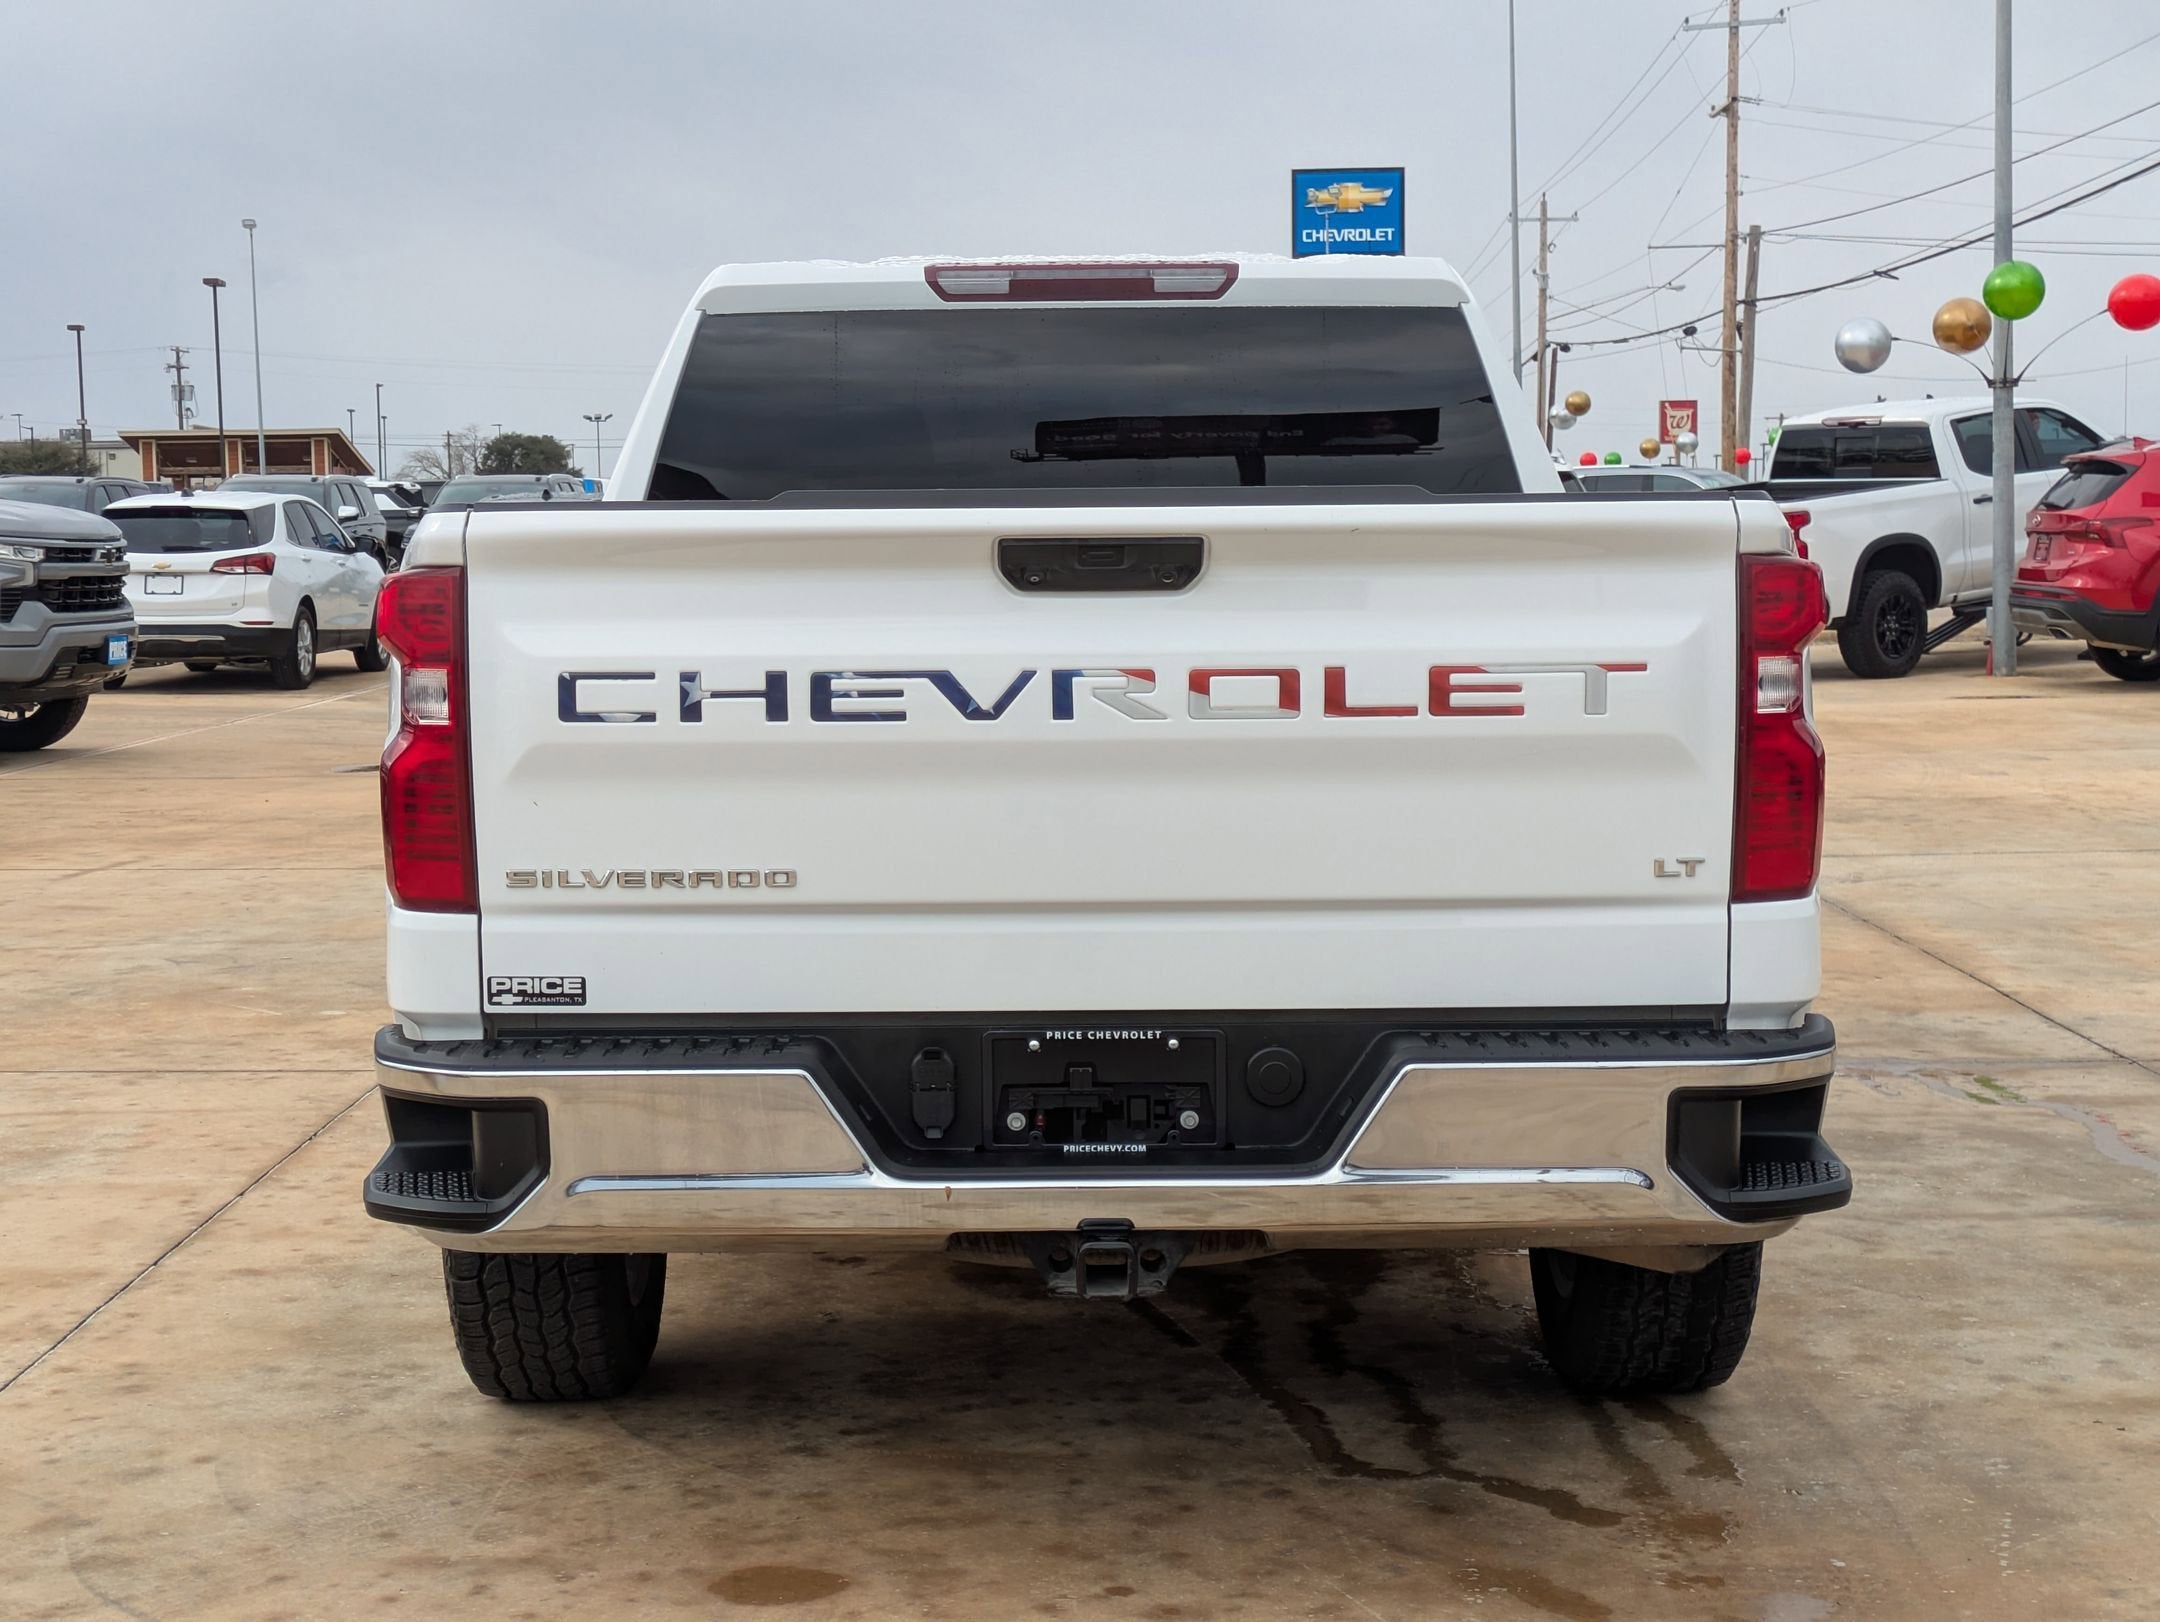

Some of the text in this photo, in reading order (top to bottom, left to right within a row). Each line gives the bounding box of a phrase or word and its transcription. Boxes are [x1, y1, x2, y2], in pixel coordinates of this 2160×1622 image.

[1302, 228, 1395, 242] CHEVROLET
[558, 663, 1648, 723] CHEVROLET
[1653, 858, 1706, 878] LT
[505, 869, 798, 888] SILVERADO
[490, 977, 583, 994] PRICE
[1046, 1030, 1162, 1040] PRICE CHEVROLET
[1063, 1144, 1147, 1153] PRICECHEVY.COM
